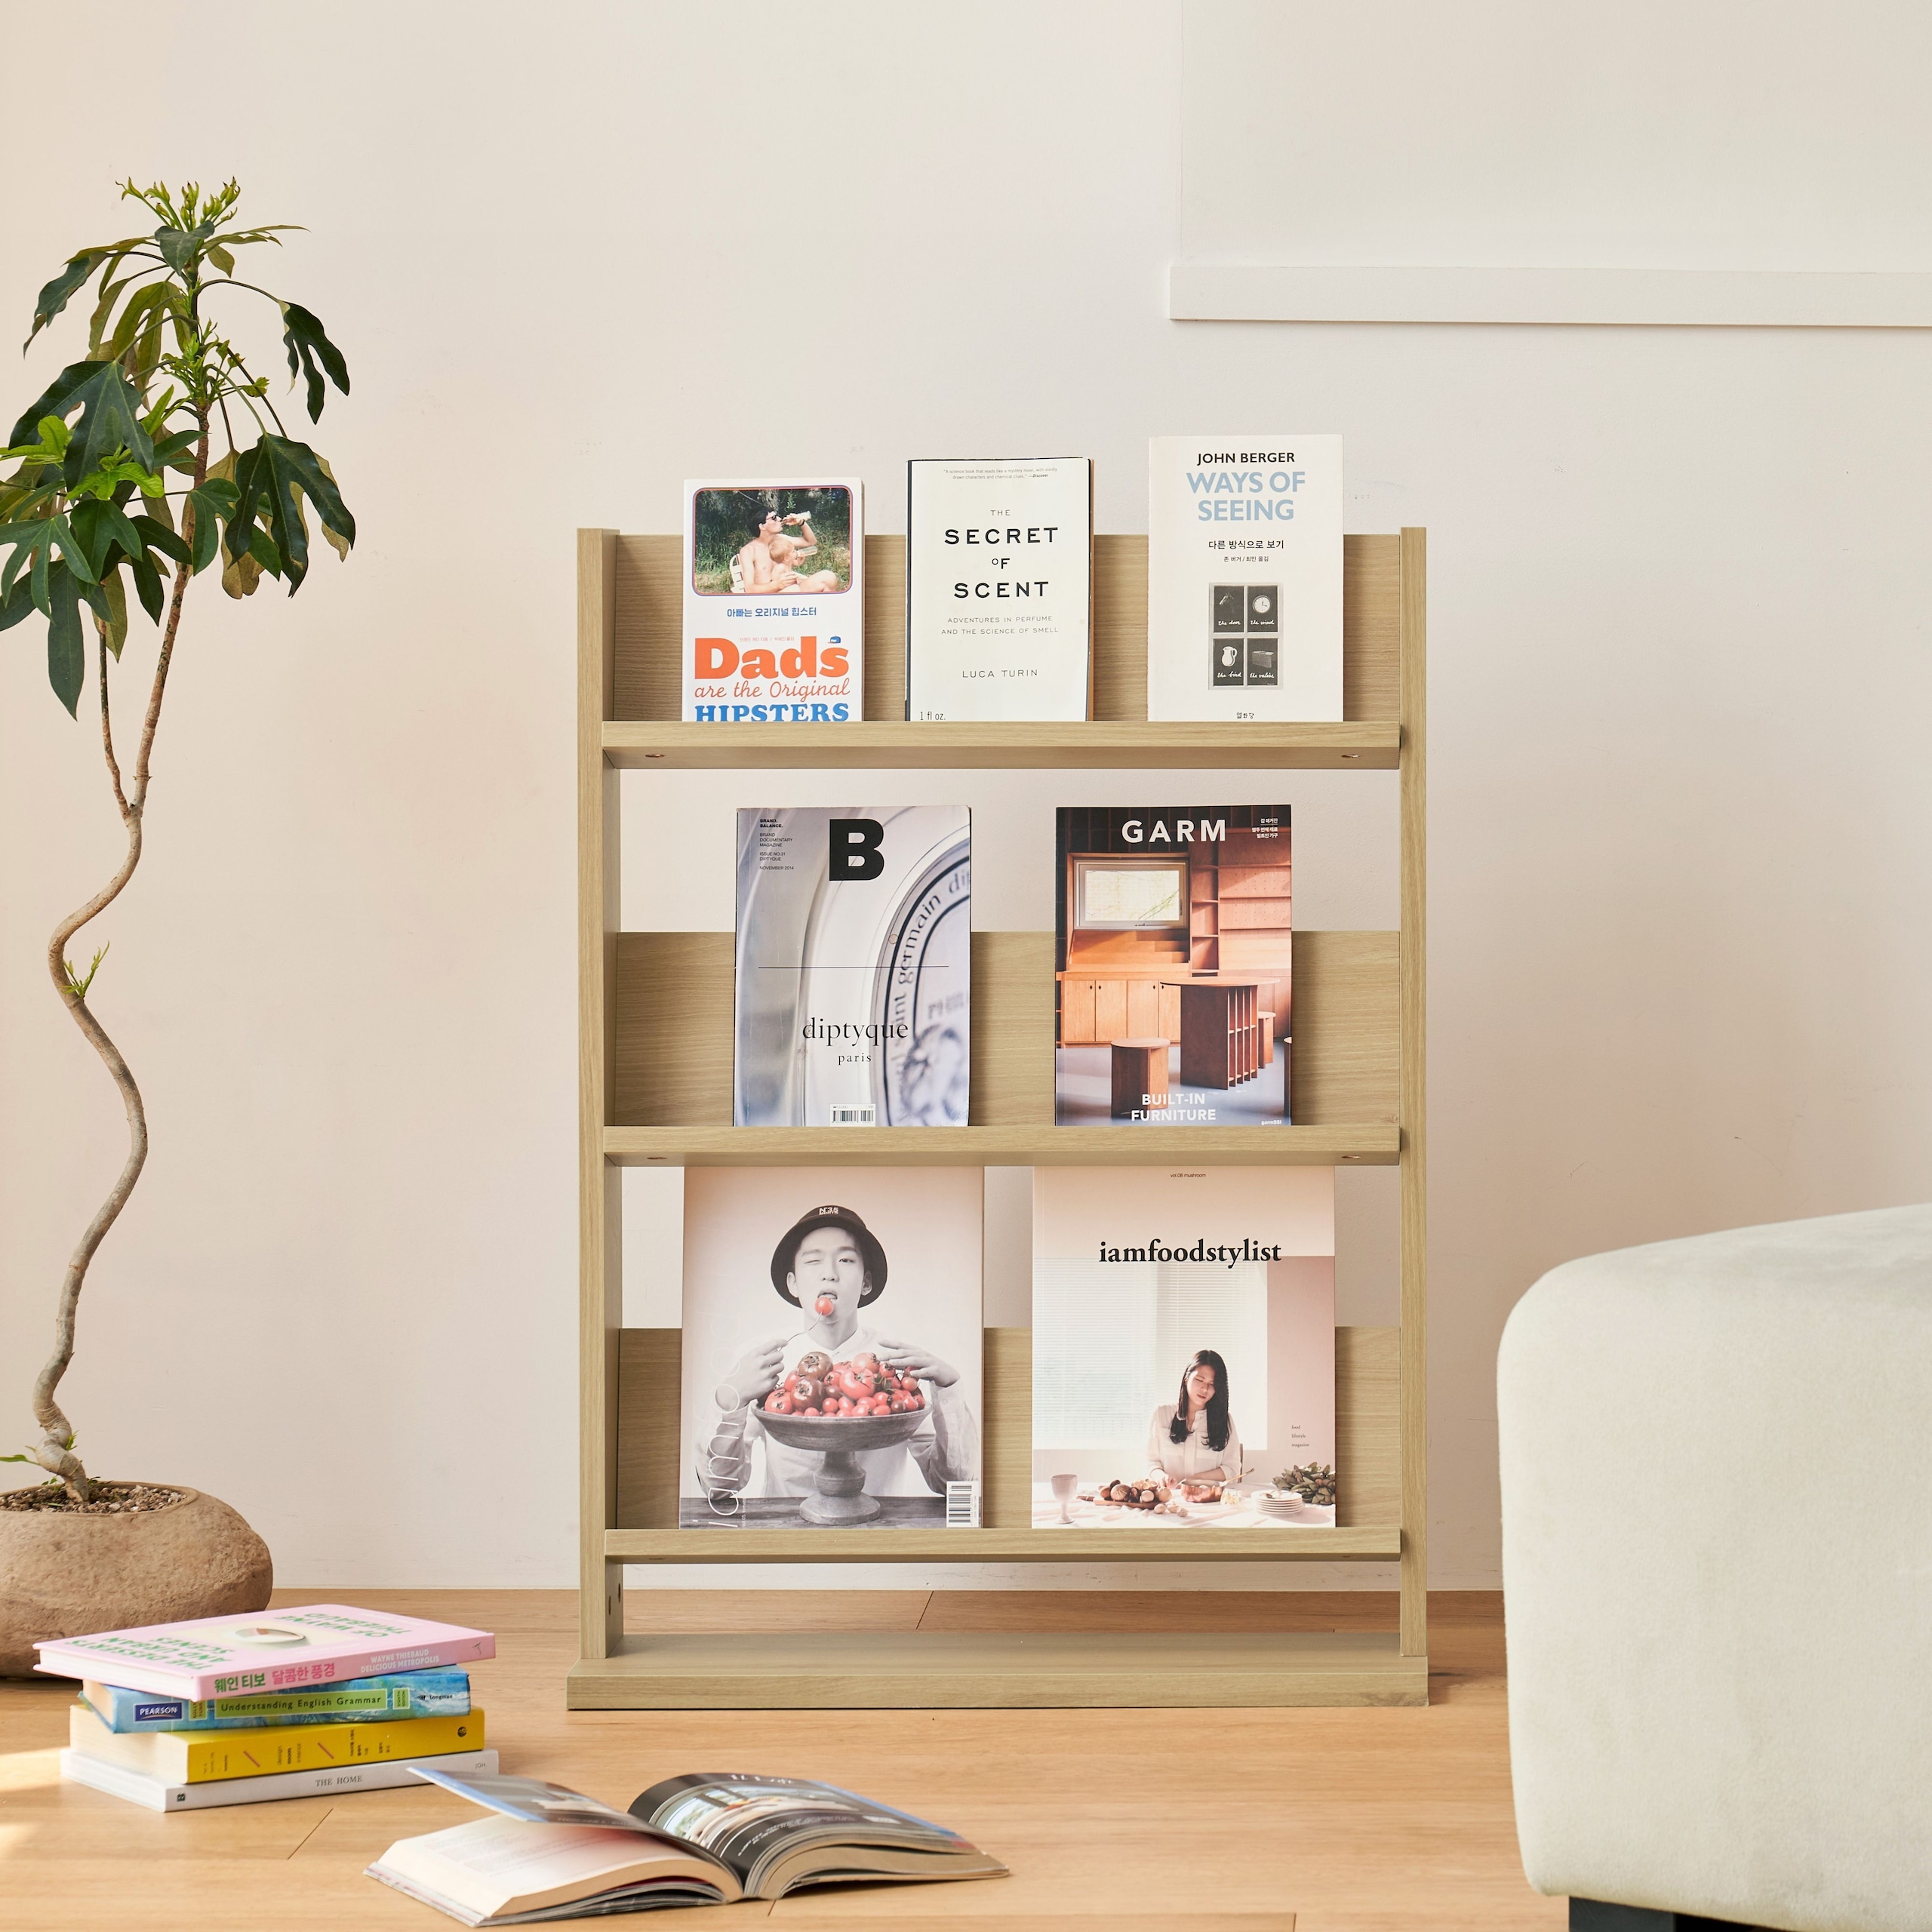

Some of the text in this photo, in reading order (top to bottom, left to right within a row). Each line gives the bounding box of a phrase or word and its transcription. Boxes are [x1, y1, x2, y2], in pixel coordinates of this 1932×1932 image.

[1197, 452, 1295, 466] JOHN BERGER
[1186, 471, 1306, 494] WAYS OF
[1198, 499, 1294, 521] SEEING
[944, 527, 1058, 544] SECRET
[1208, 540, 1284, 549] 다른 방식으로 보기
[992, 558, 1010, 569] OF
[954, 581, 1048, 598] SCENT
[727, 607, 817, 617] 아빠는 오리지널 힙스터
[962, 669, 1038, 678] LUCA TURIN
[694, 678, 851, 702] are the Original
[694, 703, 850, 721] HIPSTERS
[1121, 819, 1226, 843] GARM
[829, 819, 884, 881] B
[802, 1017, 909, 1047] diptyque
[838, 1052, 872, 1066] paris
[1142, 1093, 1205, 1105] BUILT-IN
[1131, 1109, 1217, 1121] FURNITURE
[1099, 1238, 1282, 1269] iamfoodstylist
[275, 1615, 354, 1632] WAYNE
[303, 1613, 412, 1635] THIEBAUD
[352, 1629, 388, 1638] OF
[101, 1637, 233, 1663] AND URBAN
[149, 1637, 235, 1654] SCENES
[65, 1639, 213, 1670] THE DESSERTS
[371, 1648, 429, 1663] WAYNE THIEBAUD
[361, 1655, 439, 1673] DELICIOUS METROPOLIS
[214, 1662, 335, 1694] 웨인 티보 달콤한 풍경
[140, 1706, 178, 1715] PEARSON
[221, 1695, 381, 1712] Understanding English Grammar
[315, 1775, 363, 1787] THE HOME
